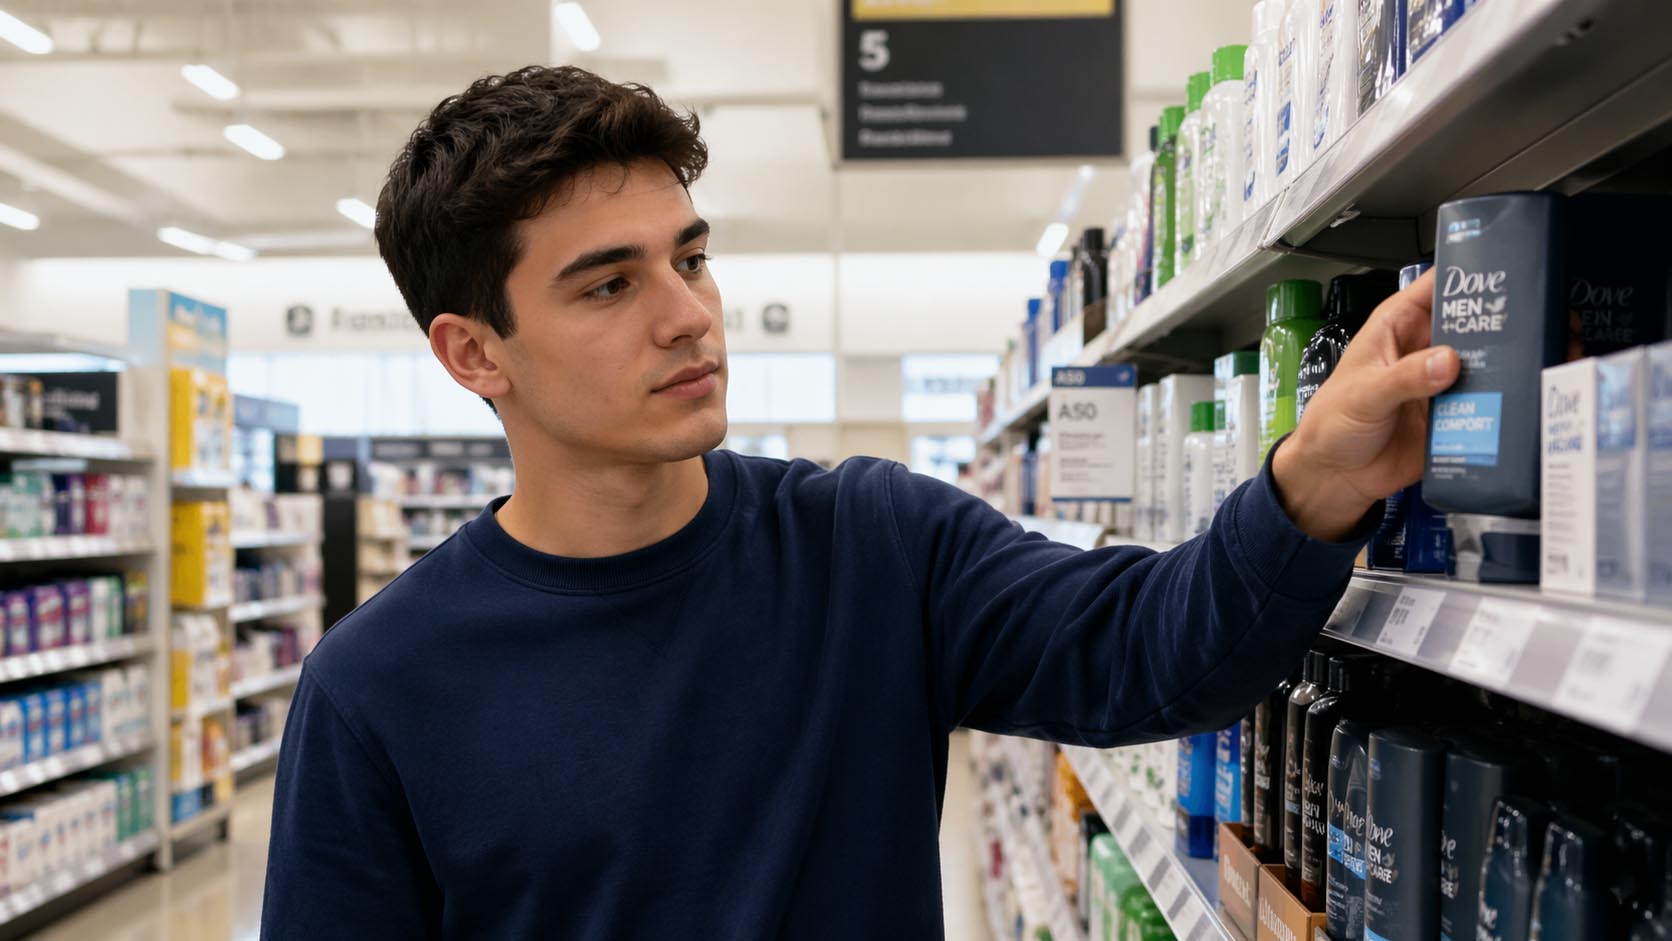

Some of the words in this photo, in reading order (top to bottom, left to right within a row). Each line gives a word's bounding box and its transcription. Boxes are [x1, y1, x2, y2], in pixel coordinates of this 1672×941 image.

[859, 30, 890, 71] 5
[1443, 266, 1506, 296] Dove
[1442, 297, 1483, 319] MEN
[1584, 309, 1612, 327] EN
[1438, 401, 1476, 417] CLEAN
